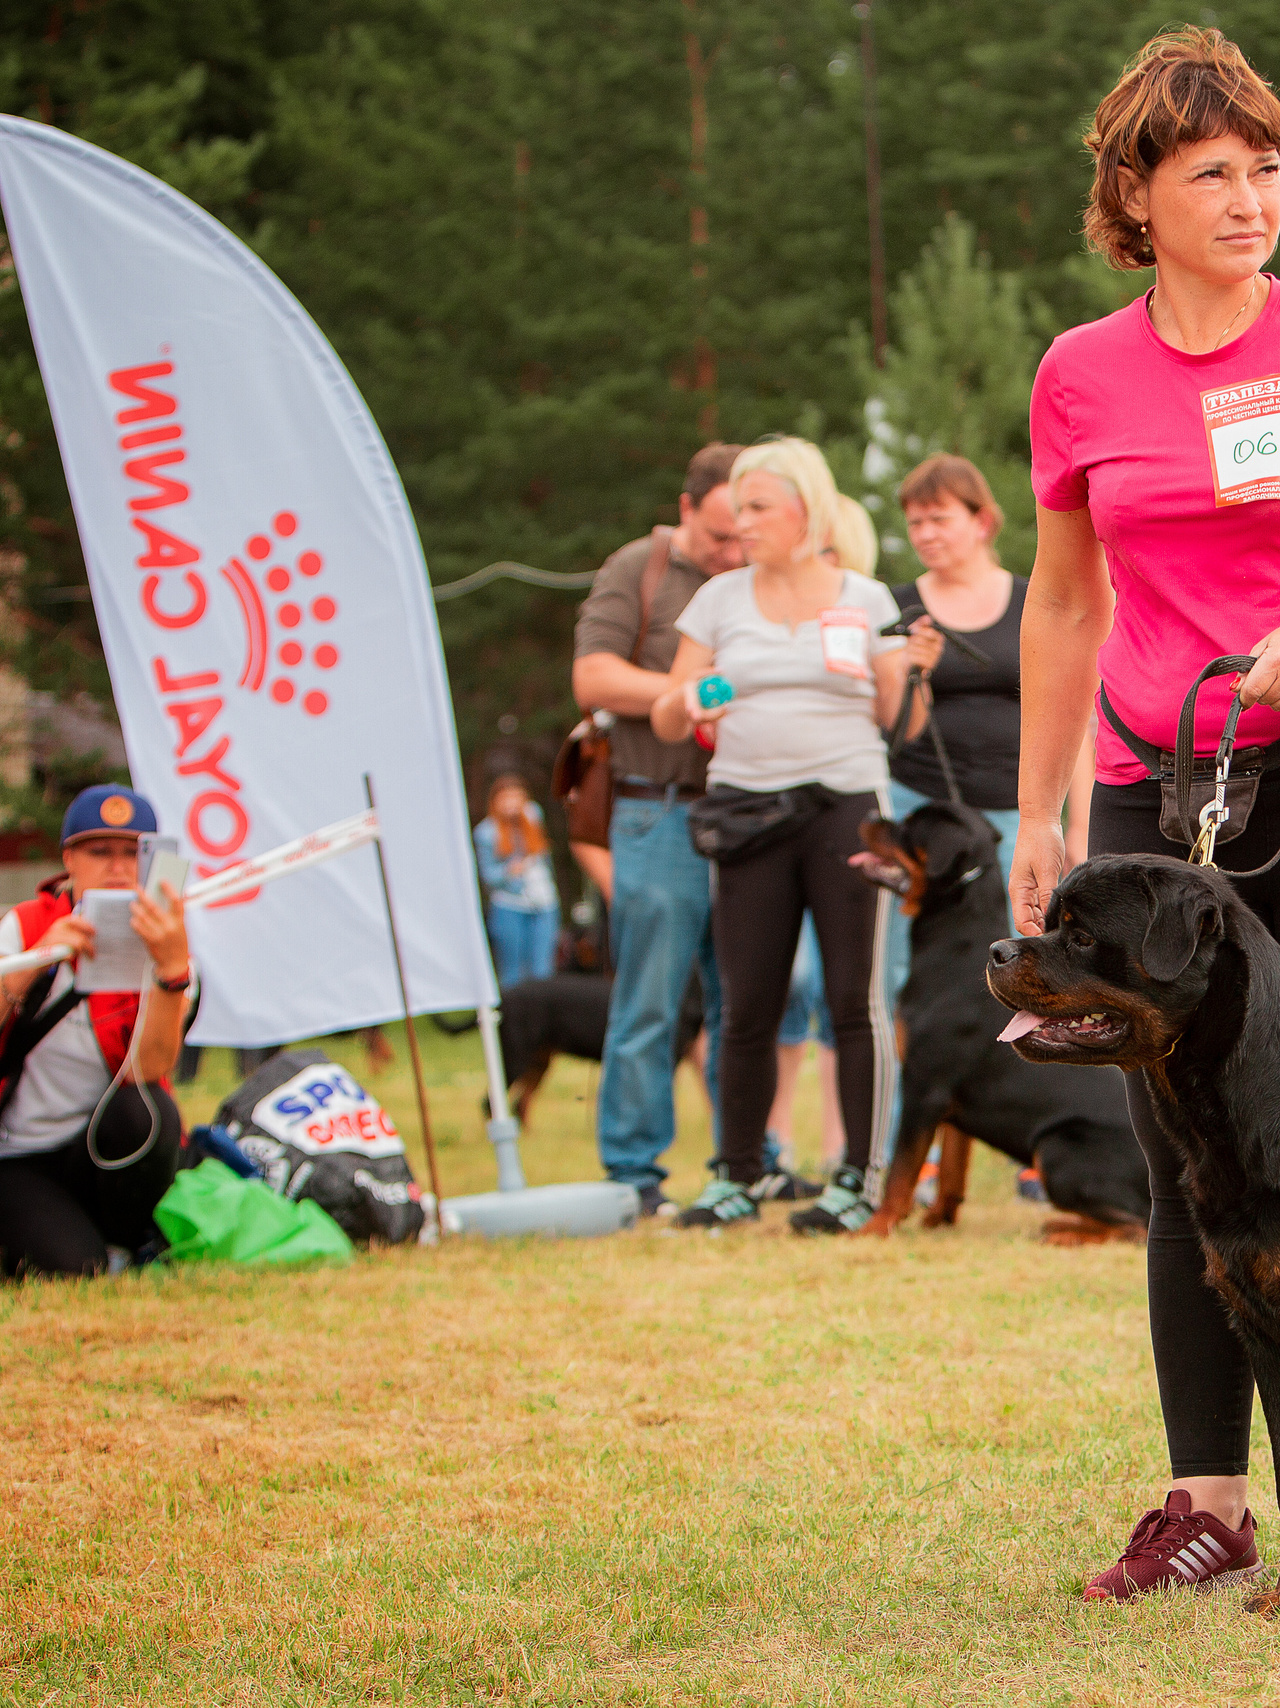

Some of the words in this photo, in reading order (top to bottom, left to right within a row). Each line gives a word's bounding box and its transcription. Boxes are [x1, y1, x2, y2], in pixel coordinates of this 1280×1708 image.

[1206, 397, 1275, 421] ПРОФЕССИОНАЛЬНЫЙ
[1233, 408, 1261, 420] ЧЕСТНОЙ
[1233, 431, 1277, 464] 06
